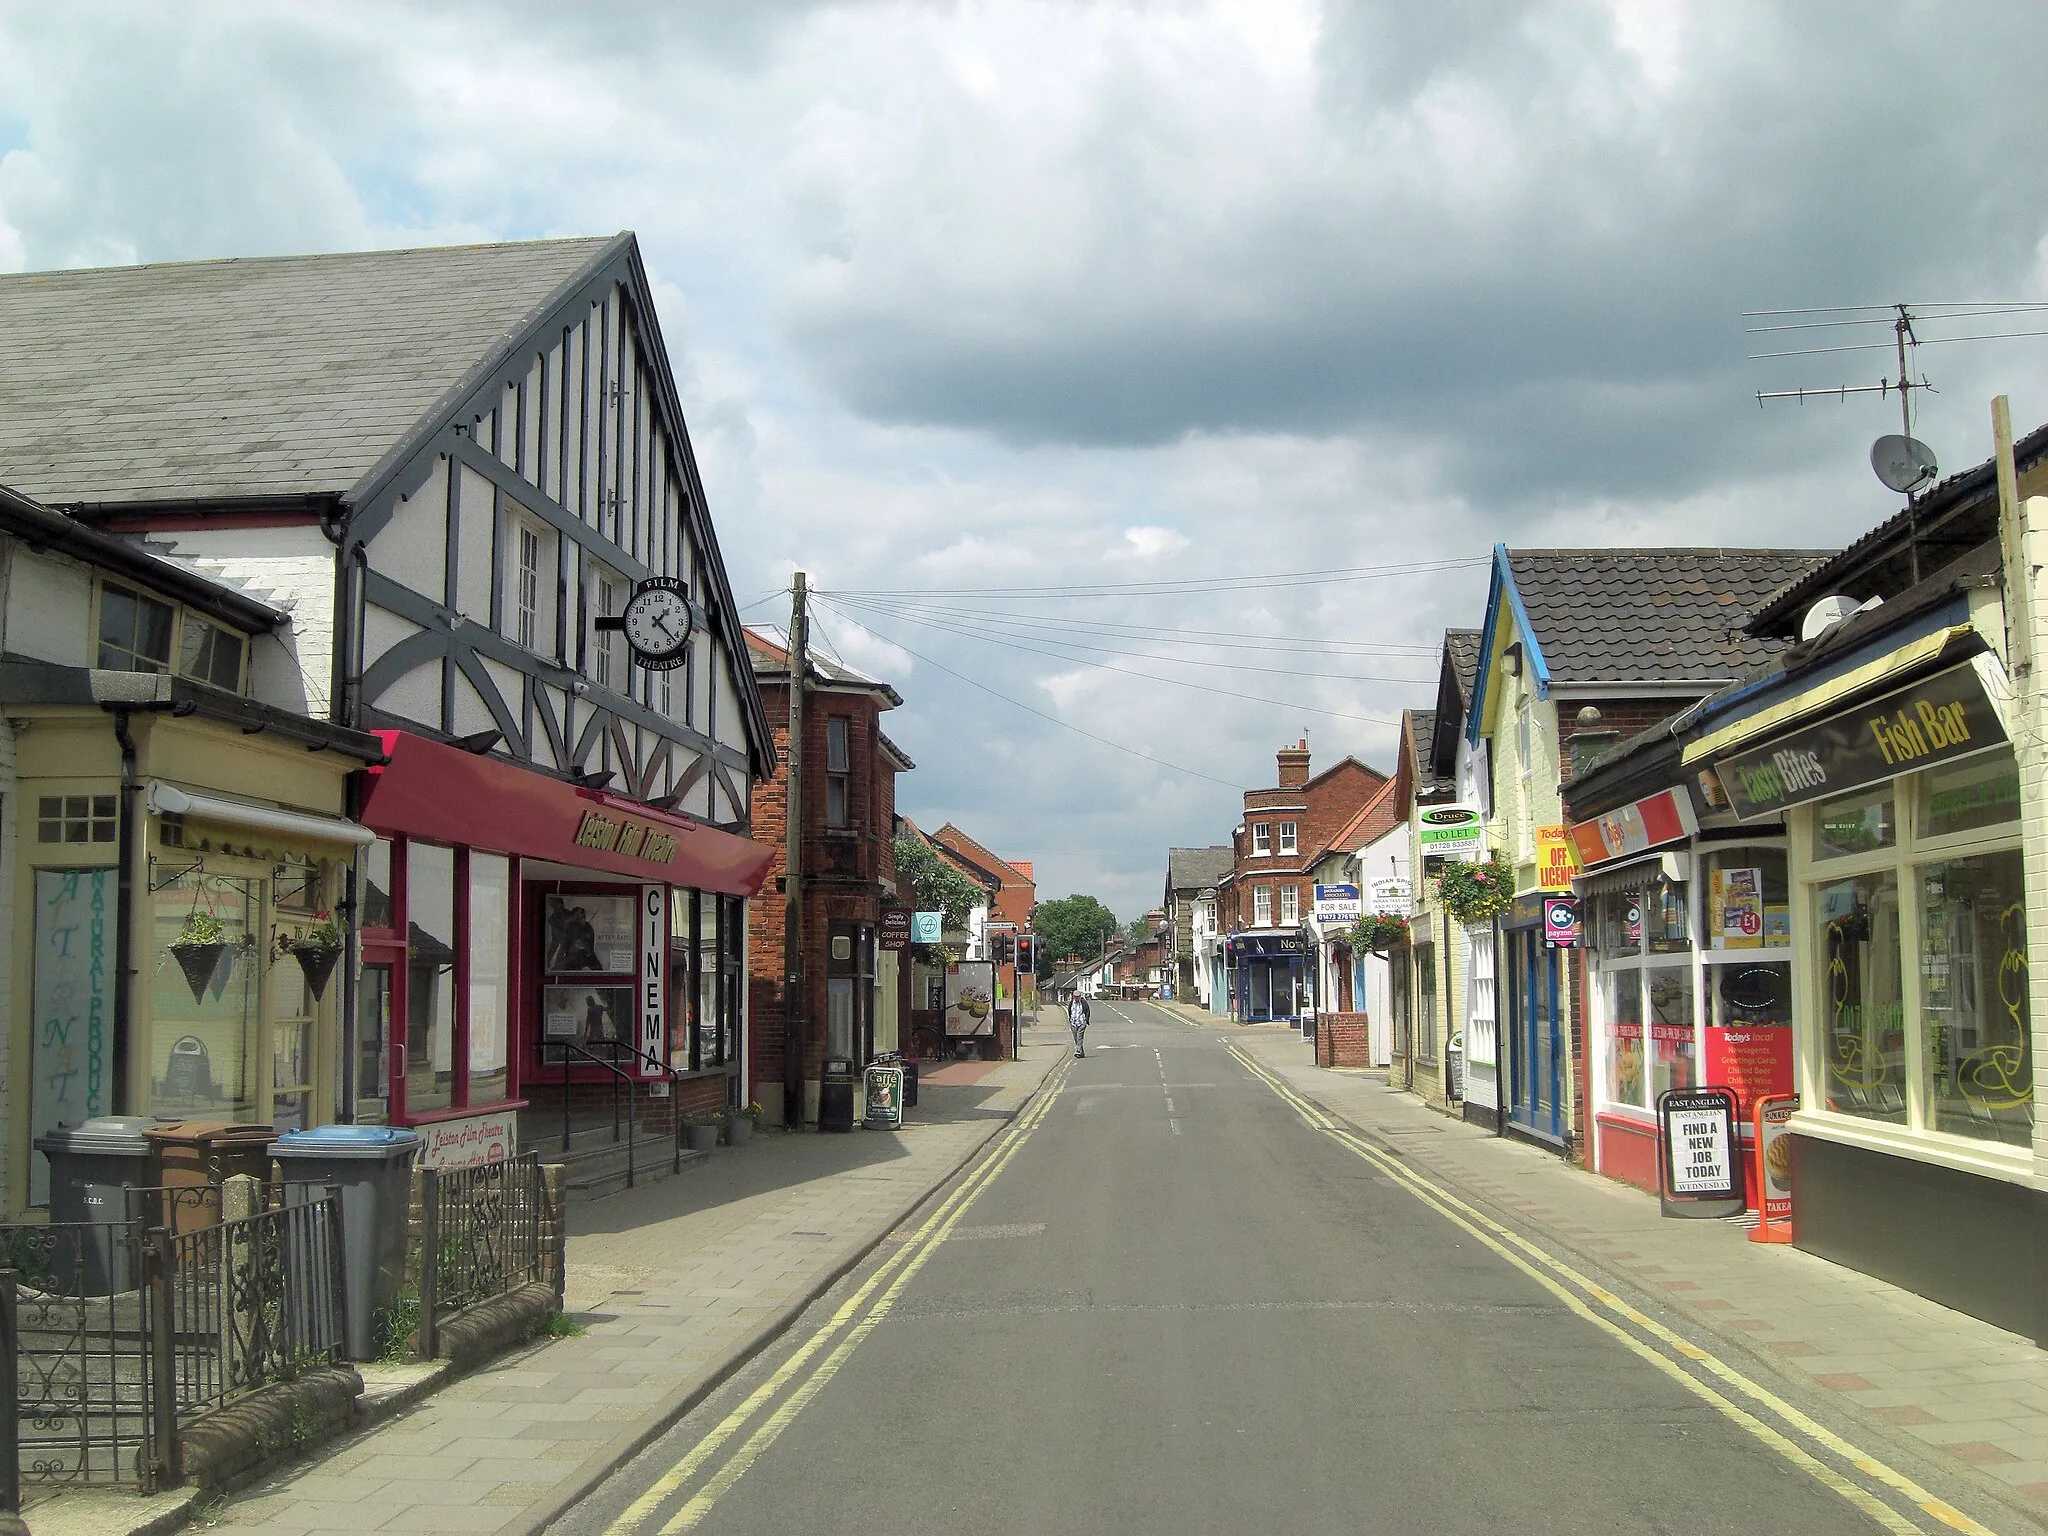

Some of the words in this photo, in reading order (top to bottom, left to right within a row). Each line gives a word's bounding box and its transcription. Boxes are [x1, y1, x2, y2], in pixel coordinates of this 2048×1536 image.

[646, 579, 679, 589] FILM
[637, 657, 683, 669] THEATRE
[1868, 711, 1929, 765] Fish
[1916, 699, 1971, 749] Bar
[1735, 762, 1785, 803] Tasty
[1772, 748, 1827, 793] Bites
[1434, 812, 1466, 820] Druce
[574, 810, 620, 852] Leiston
[615, 822, 643, 857] Film
[639, 828, 680, 864] Theatre
[1433, 830, 1448, 840] TO
[1451, 829, 1470, 838] LET
[1550, 847, 1567, 866] OFF
[1371, 878, 1394, 888] INDIAN
[1338, 903, 1356, 911] SALE
[1744, 914, 1756, 929] £1
[645, 890, 660, 1071] CINEMA
[1723, 1032, 1750, 1043] Today's
[1752, 1033, 1774, 1041] local
[1728, 1047, 1770, 1055] Newsagents
[1721, 1057, 1755, 1065] Greetings
[1728, 1066, 1752, 1074] Chilled
[1690, 1098, 1726, 1106] ANGLIAN
[1691, 1109, 1722, 1118] ANGLIAN
[1682, 1122, 1707, 1135] FIND
[1710, 1122, 1717, 1134] A
[431, 1129, 459, 1158] Leiston
[460, 1124, 478, 1148] Film
[479, 1121, 504, 1144] Theatre
[1689, 1137, 1714, 1150] NEW
[1693, 1151, 1713, 1164] JOB
[1685, 1165, 1721, 1178] TODAY
[1679, 1181, 1731, 1191] WEDNESDAY
